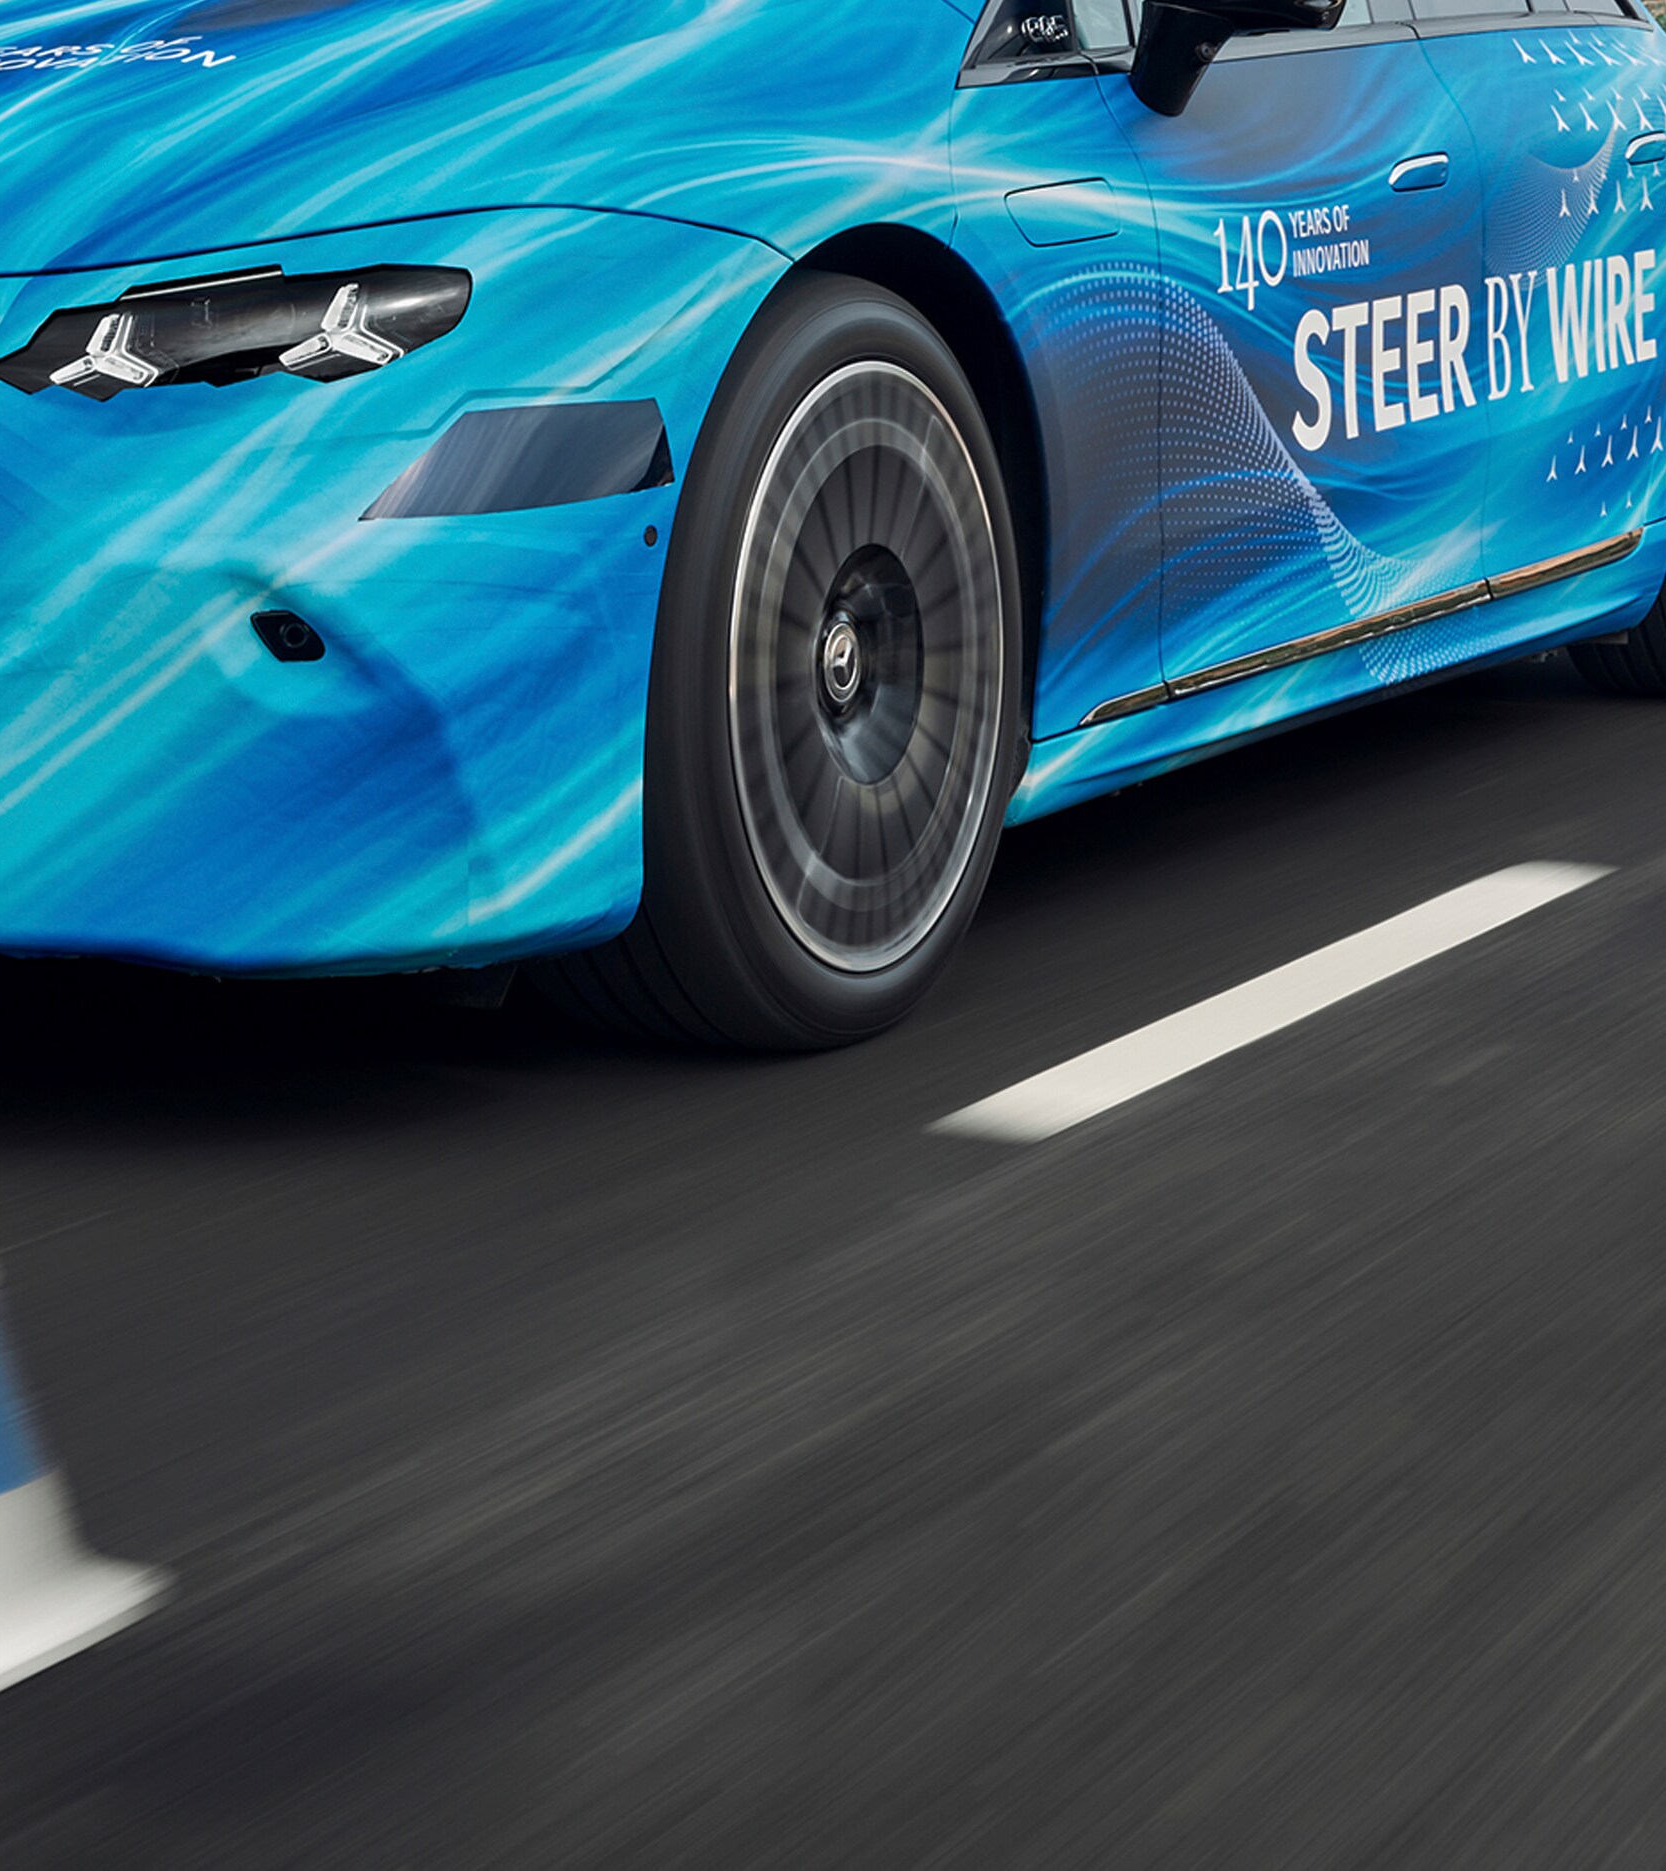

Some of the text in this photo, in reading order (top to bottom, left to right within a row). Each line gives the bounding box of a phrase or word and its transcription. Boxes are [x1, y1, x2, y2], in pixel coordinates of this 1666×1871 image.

[119, 35, 203, 54] OF
[1288, 204, 1350, 239] YEARS OF
[1213, 209, 1288, 311] 140
[1292, 239, 1370, 277] INNOVATION
[1292, 249, 1657, 452] STEER BY WIRE
